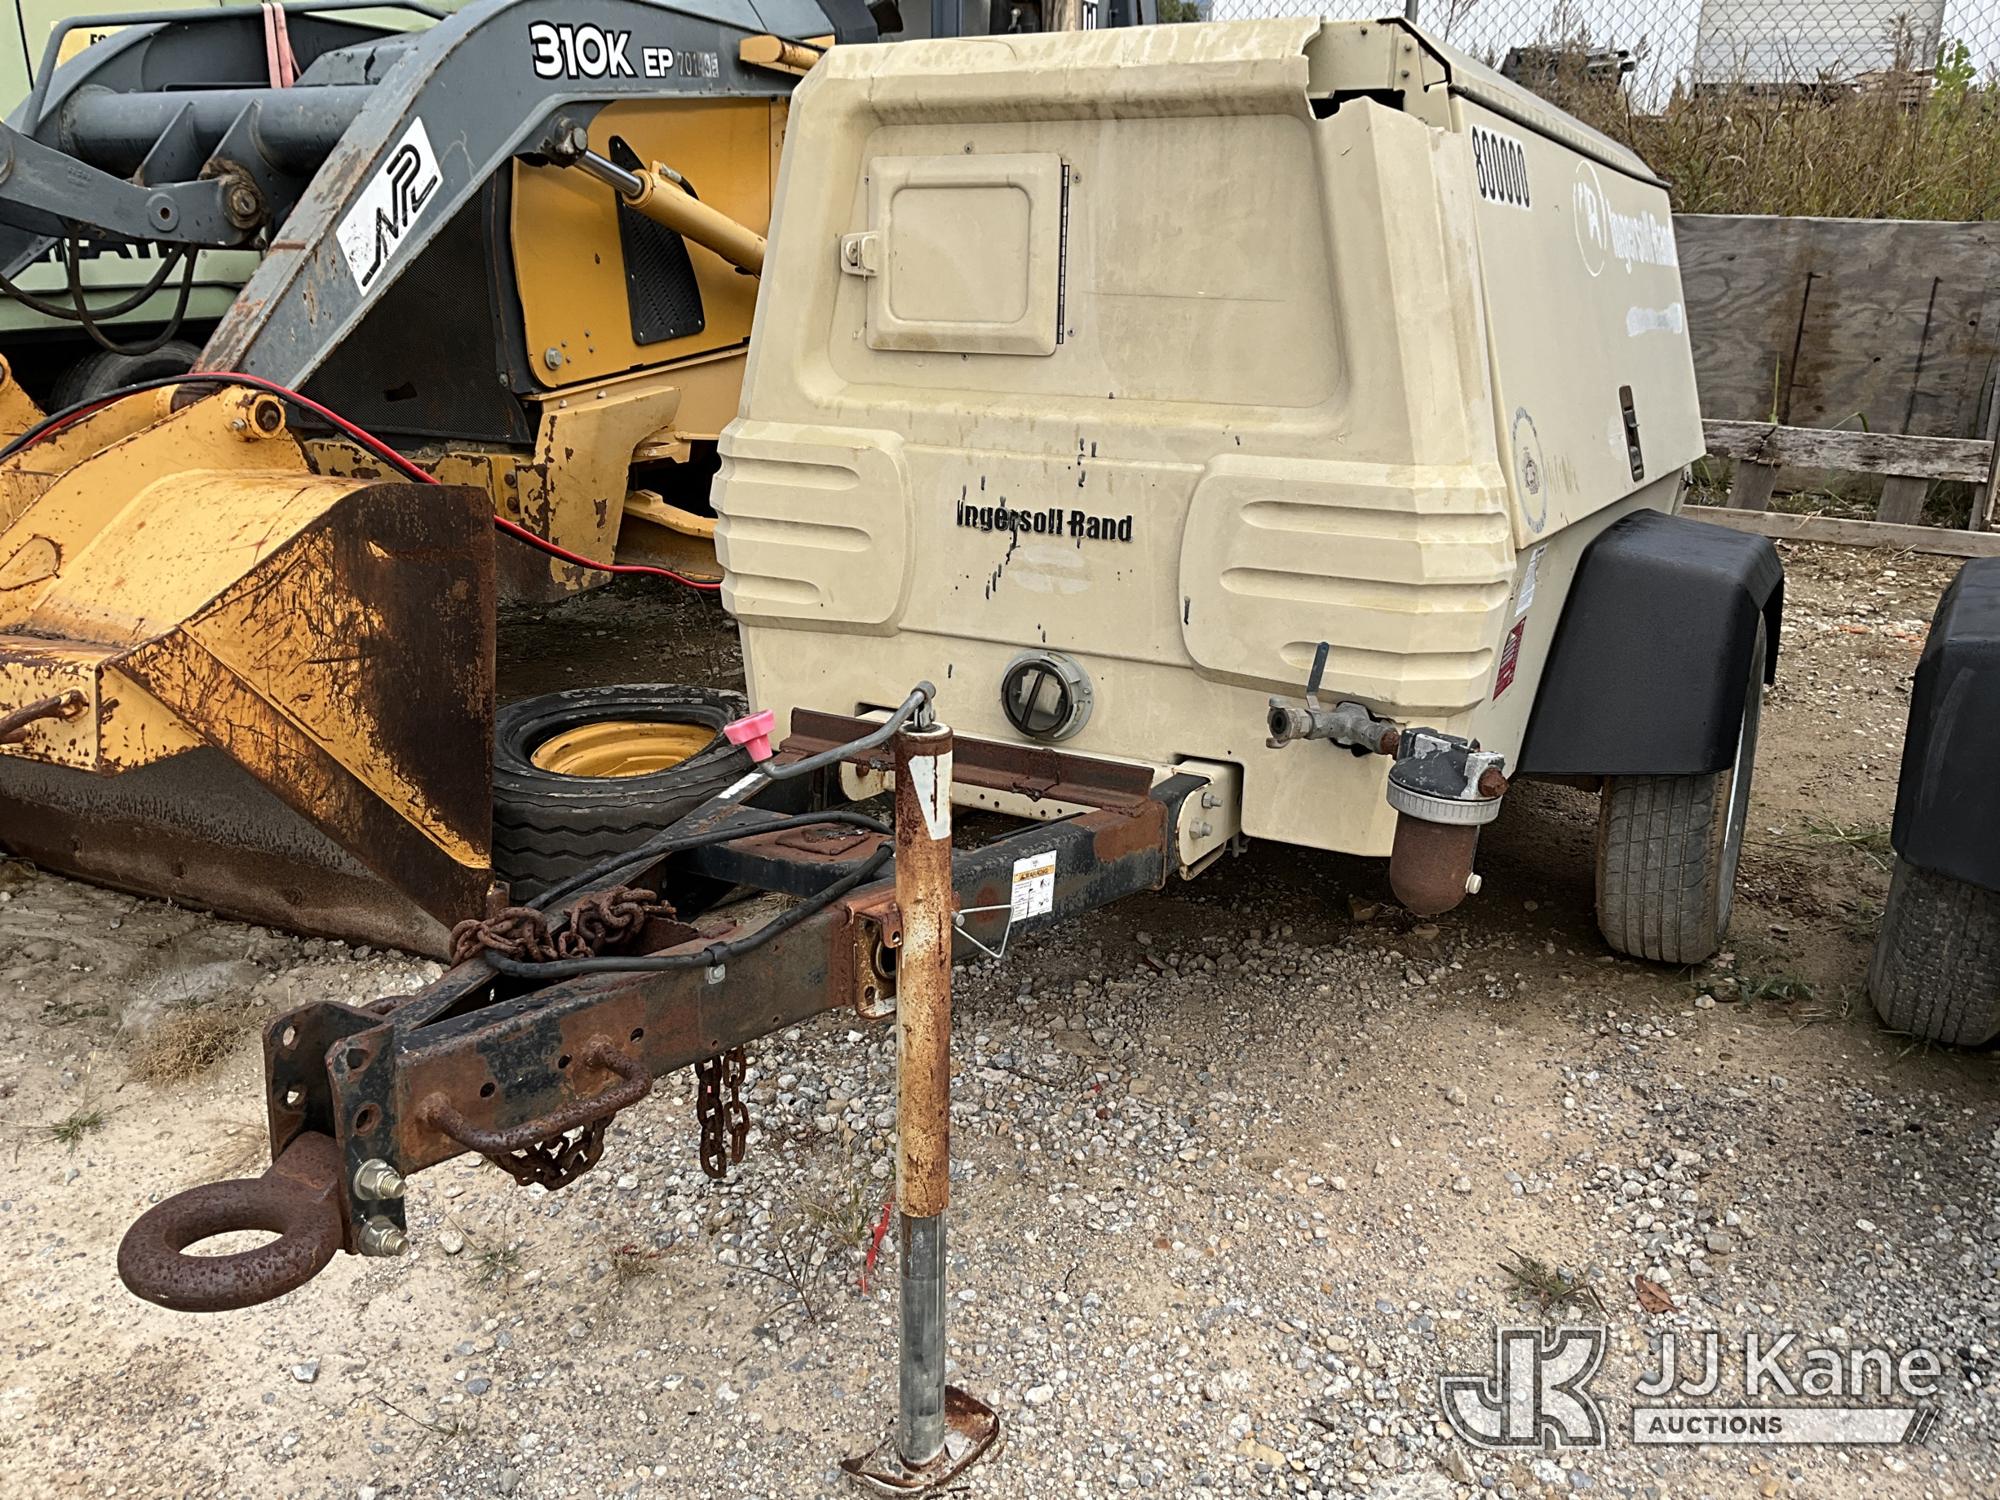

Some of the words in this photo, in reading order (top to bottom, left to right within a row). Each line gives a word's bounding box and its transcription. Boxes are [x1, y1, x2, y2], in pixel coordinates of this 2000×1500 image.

[528, 20, 638, 79] 310K
[642, 47, 674, 78] EP
[1472, 125, 1530, 208] 800000
